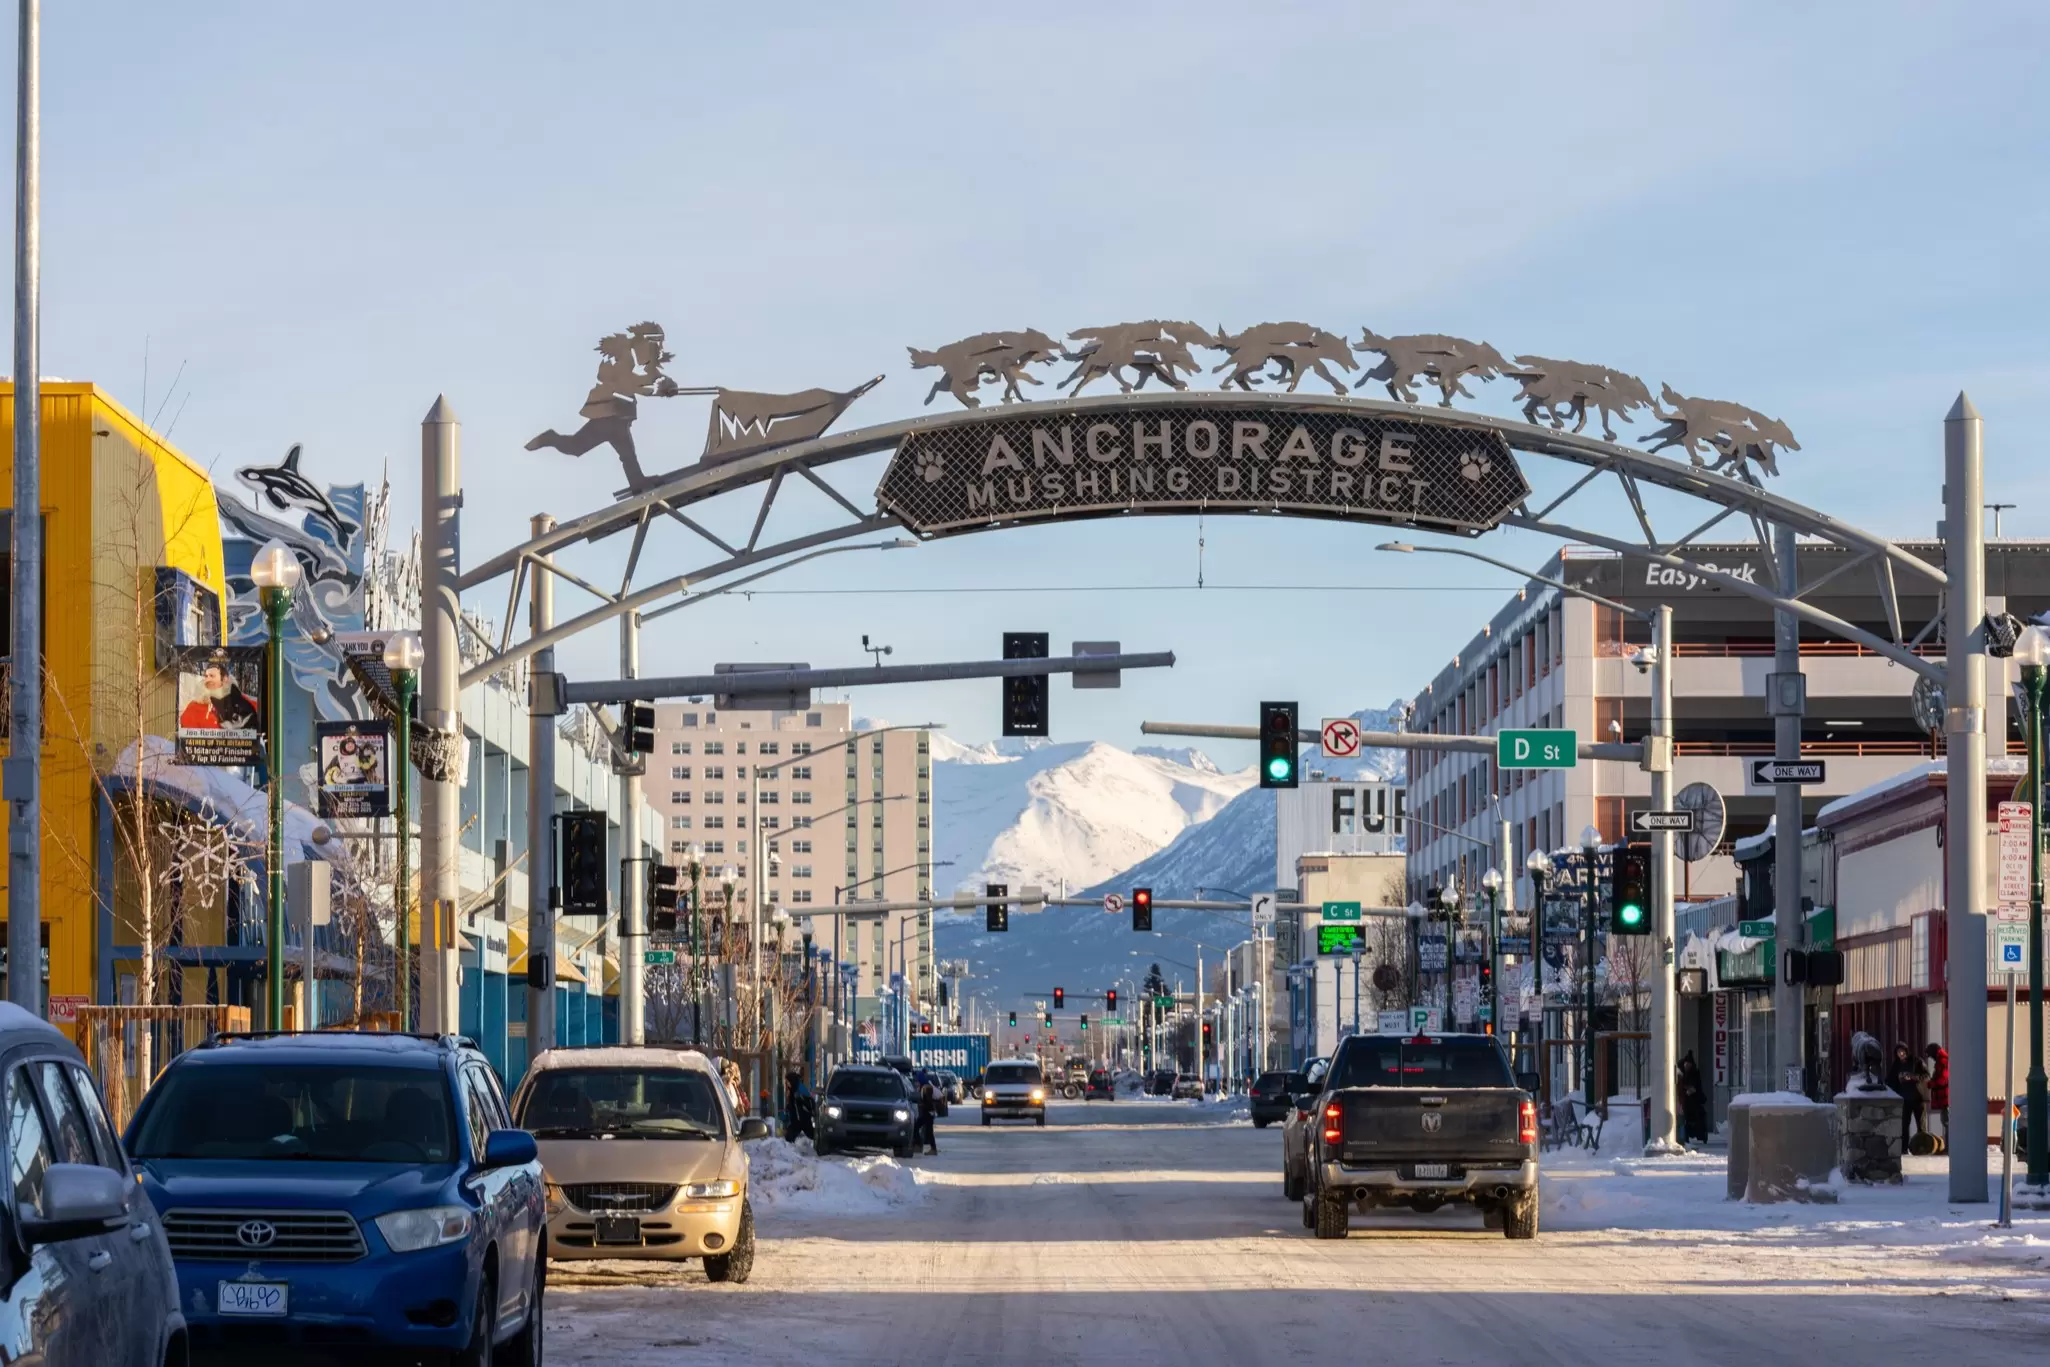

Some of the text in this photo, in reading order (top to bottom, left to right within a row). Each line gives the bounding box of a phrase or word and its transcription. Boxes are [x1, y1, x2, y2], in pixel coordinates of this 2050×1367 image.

[980, 419, 1417, 477] ANCHORAGE
[966, 466, 1430, 510] MUSHING DISTRICT
[224, 747, 252, 756] Finishes
[1515, 738, 1560, 761] D St
[198, 755, 208, 764] Top
[218, 755, 246, 763] Finishes
[1775, 766, 1817, 777] ONE WAY
[1650, 817, 1686, 825] ONE WAY
[2000, 821, 2010, 831] NO
[1331, 906, 1353, 917] C St
[50, 1003, 67, 1017] NO
[1414, 1011, 1428, 1028] P
